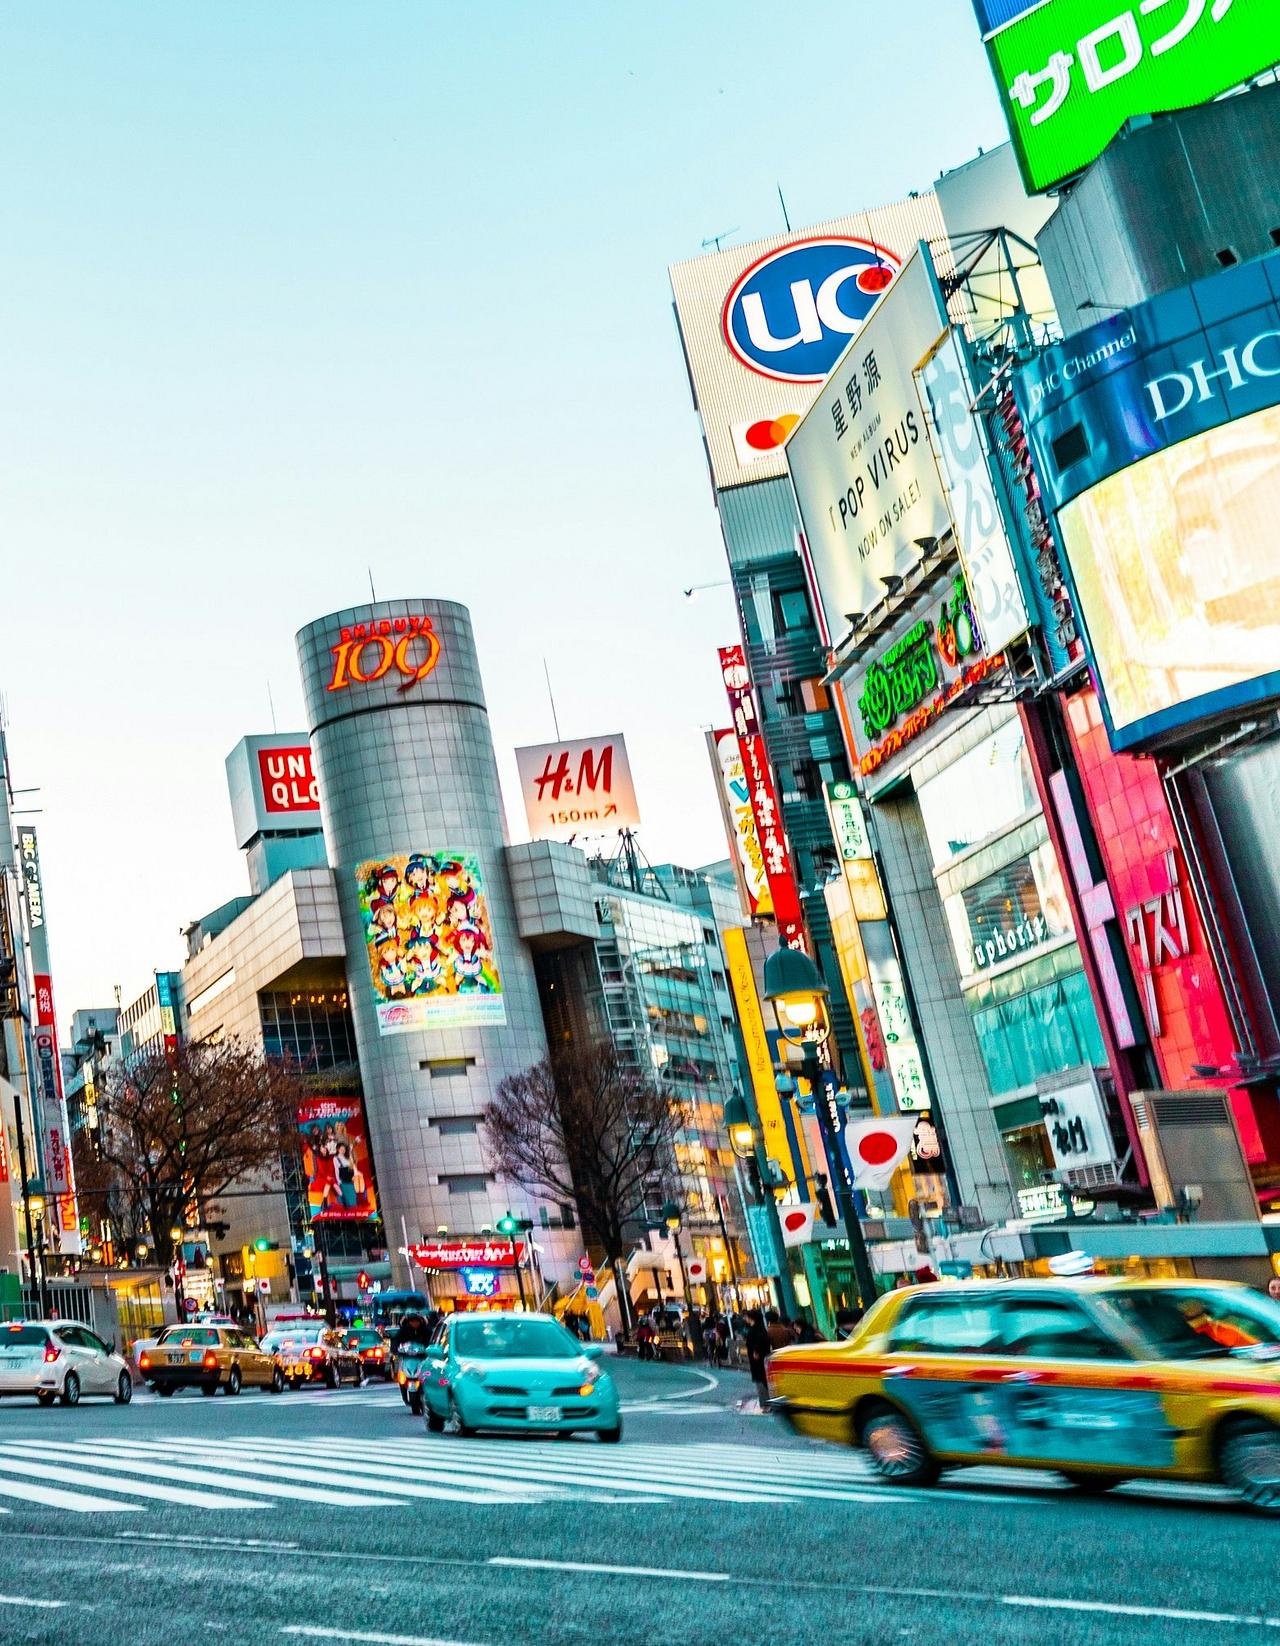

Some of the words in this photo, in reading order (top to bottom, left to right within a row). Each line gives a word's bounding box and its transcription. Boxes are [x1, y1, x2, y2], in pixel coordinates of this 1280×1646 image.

[1009, 0, 1233, 126] サロン
[832, 350, 882, 441] 星野源
[1030, 374, 1062, 405] DHC
[1063, 326, 1137, 381] Channel
[863, 413, 882, 445] ALBUM
[858, 528, 878, 563] NOW
[879, 514, 894, 538] ON
[892, 478, 922, 523] SALE!
[327, 627, 441, 695] 109
[340, 616, 434, 642] SHIBUYA
[533, 746, 613, 801] H&M
[38, 988, 52, 1013] 免税
